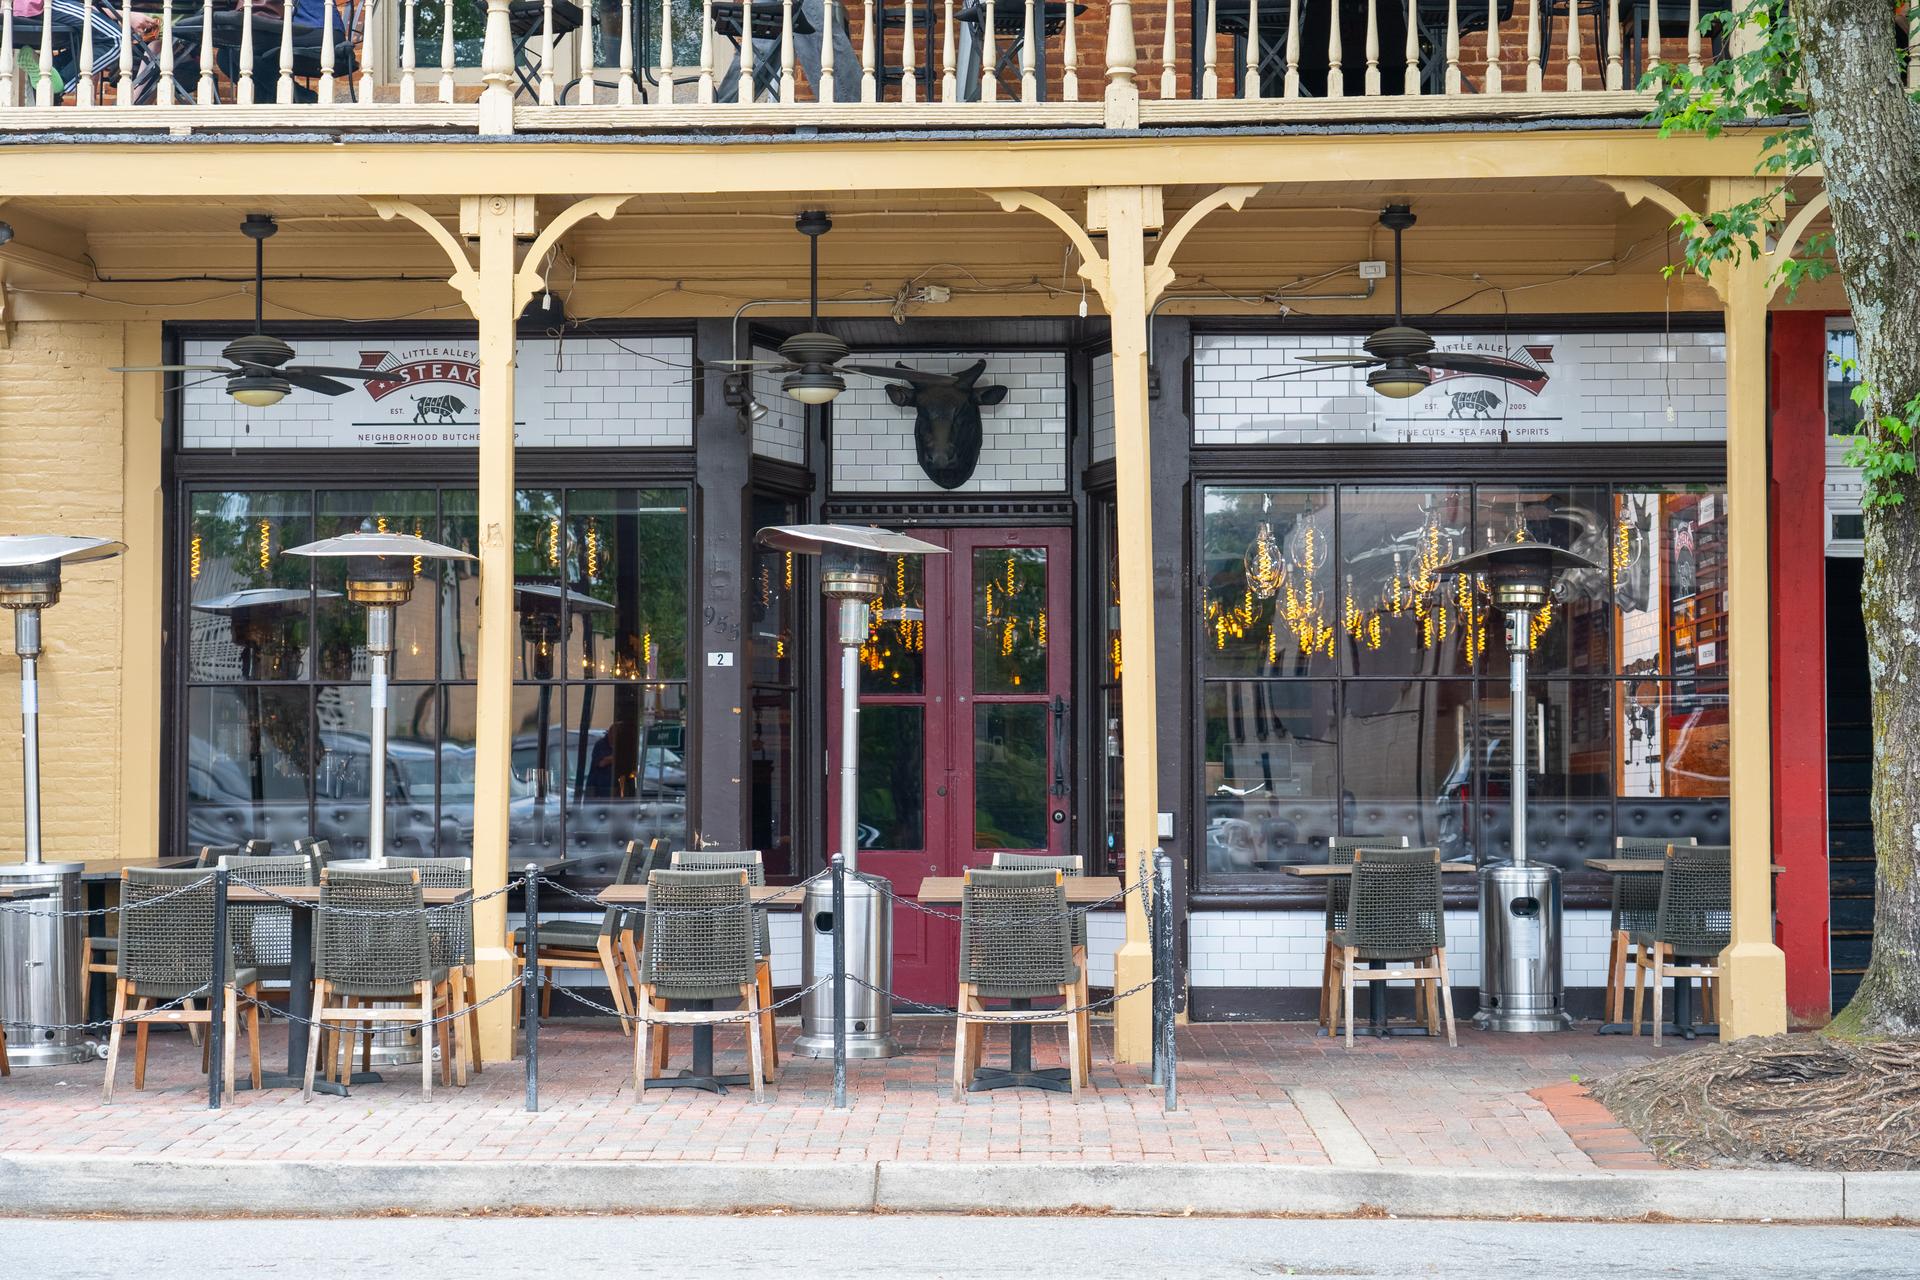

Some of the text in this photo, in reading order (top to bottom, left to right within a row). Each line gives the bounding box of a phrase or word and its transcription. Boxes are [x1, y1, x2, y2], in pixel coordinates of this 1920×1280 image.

[402, 348, 477, 359] LITTLE ALLEY
[399, 364, 479, 384] STEAK
[358, 433, 480, 441] NEIGHBORHOOD BUTCHE
[1459, 428, 1477, 436] SEA
[1480, 428, 1502, 436] FARE
[1516, 428, 1549, 436] SPIRITS
[717, 654, 724, 665] 2
